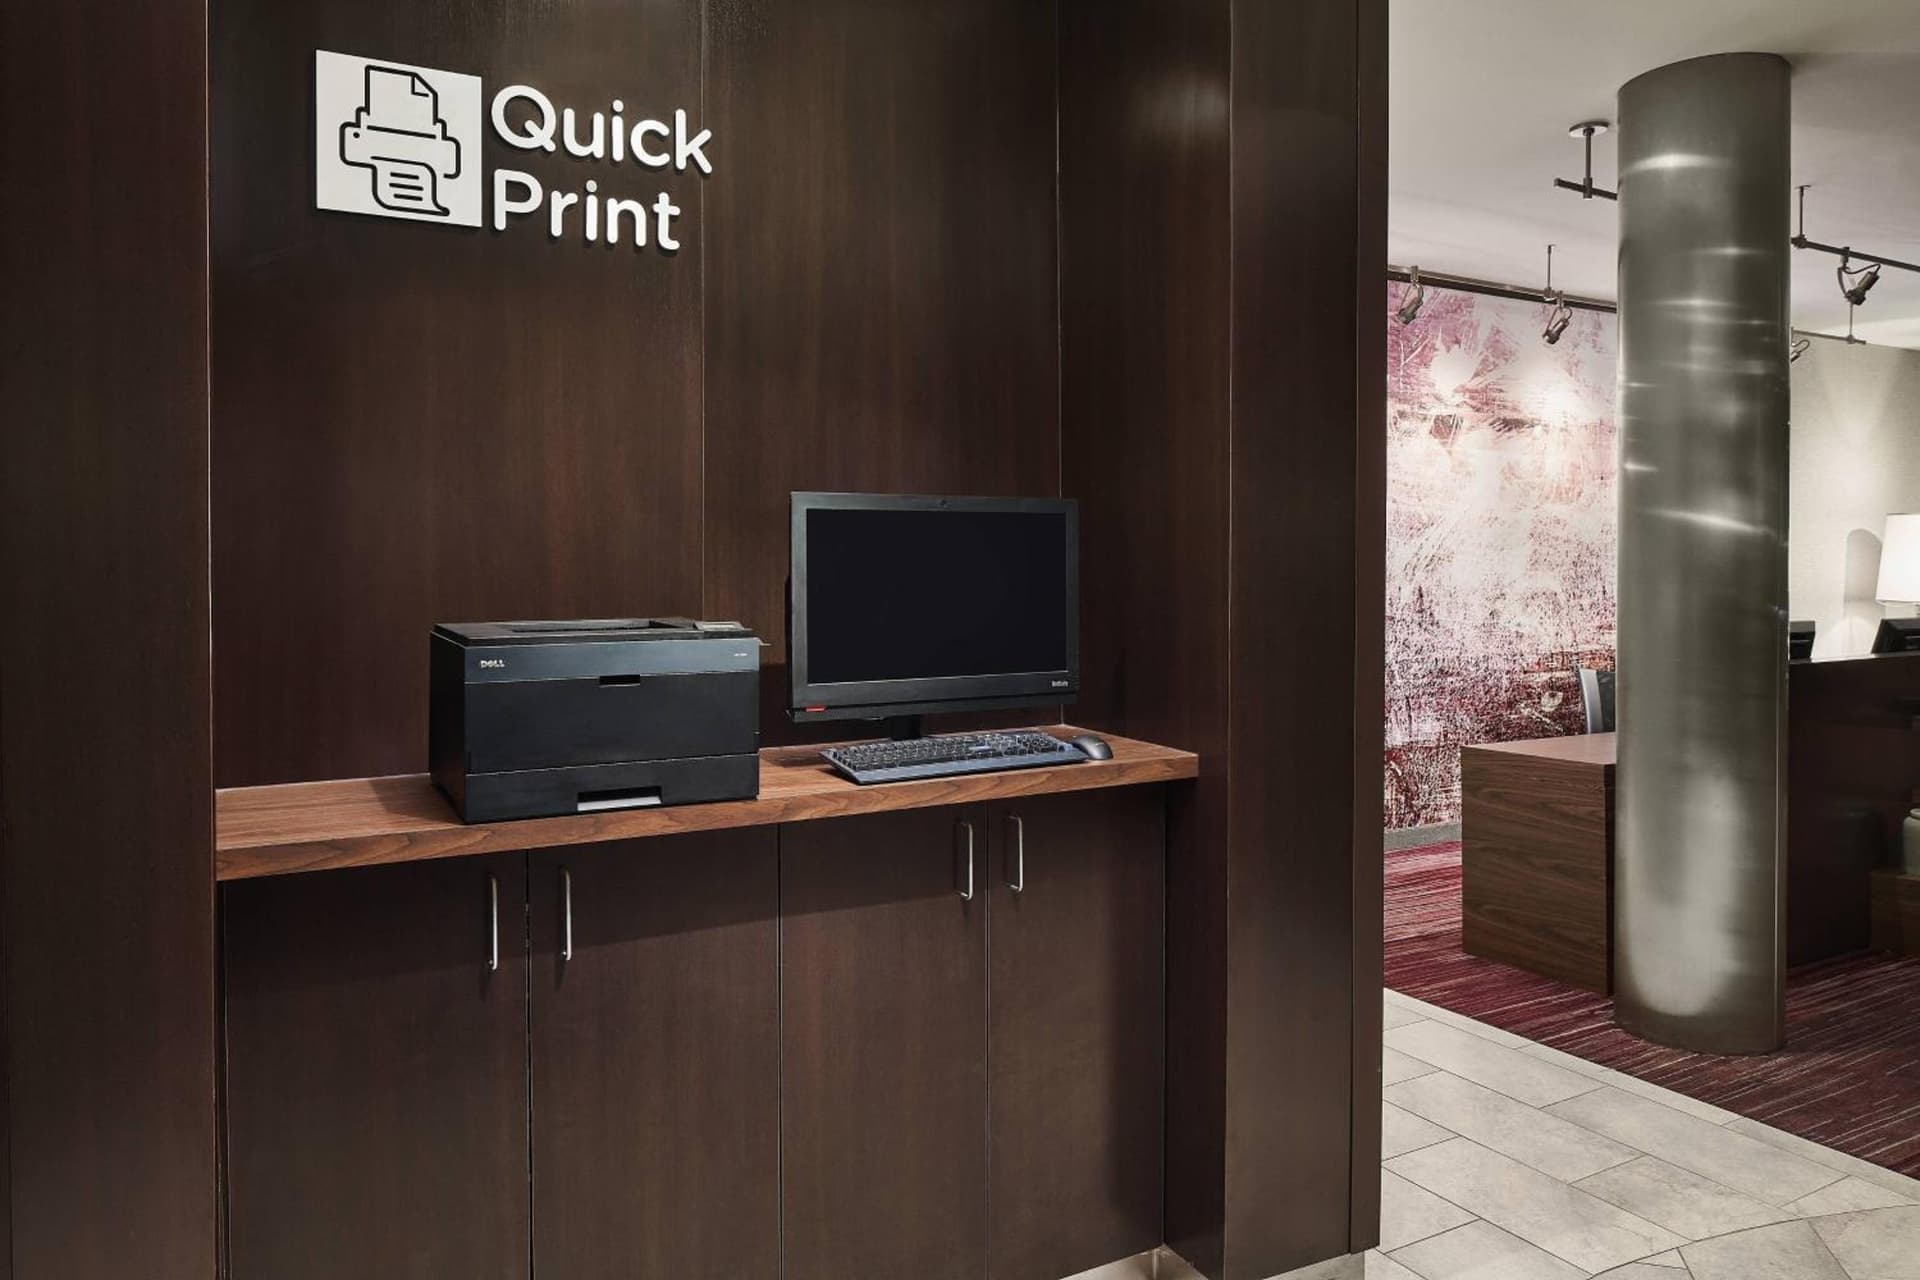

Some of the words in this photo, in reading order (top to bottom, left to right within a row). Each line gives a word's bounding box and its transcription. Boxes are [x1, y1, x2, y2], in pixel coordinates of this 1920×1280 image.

[491, 84, 713, 174] Quick
[494, 168, 681, 250] Print
[480, 659, 505, 668] DELL
